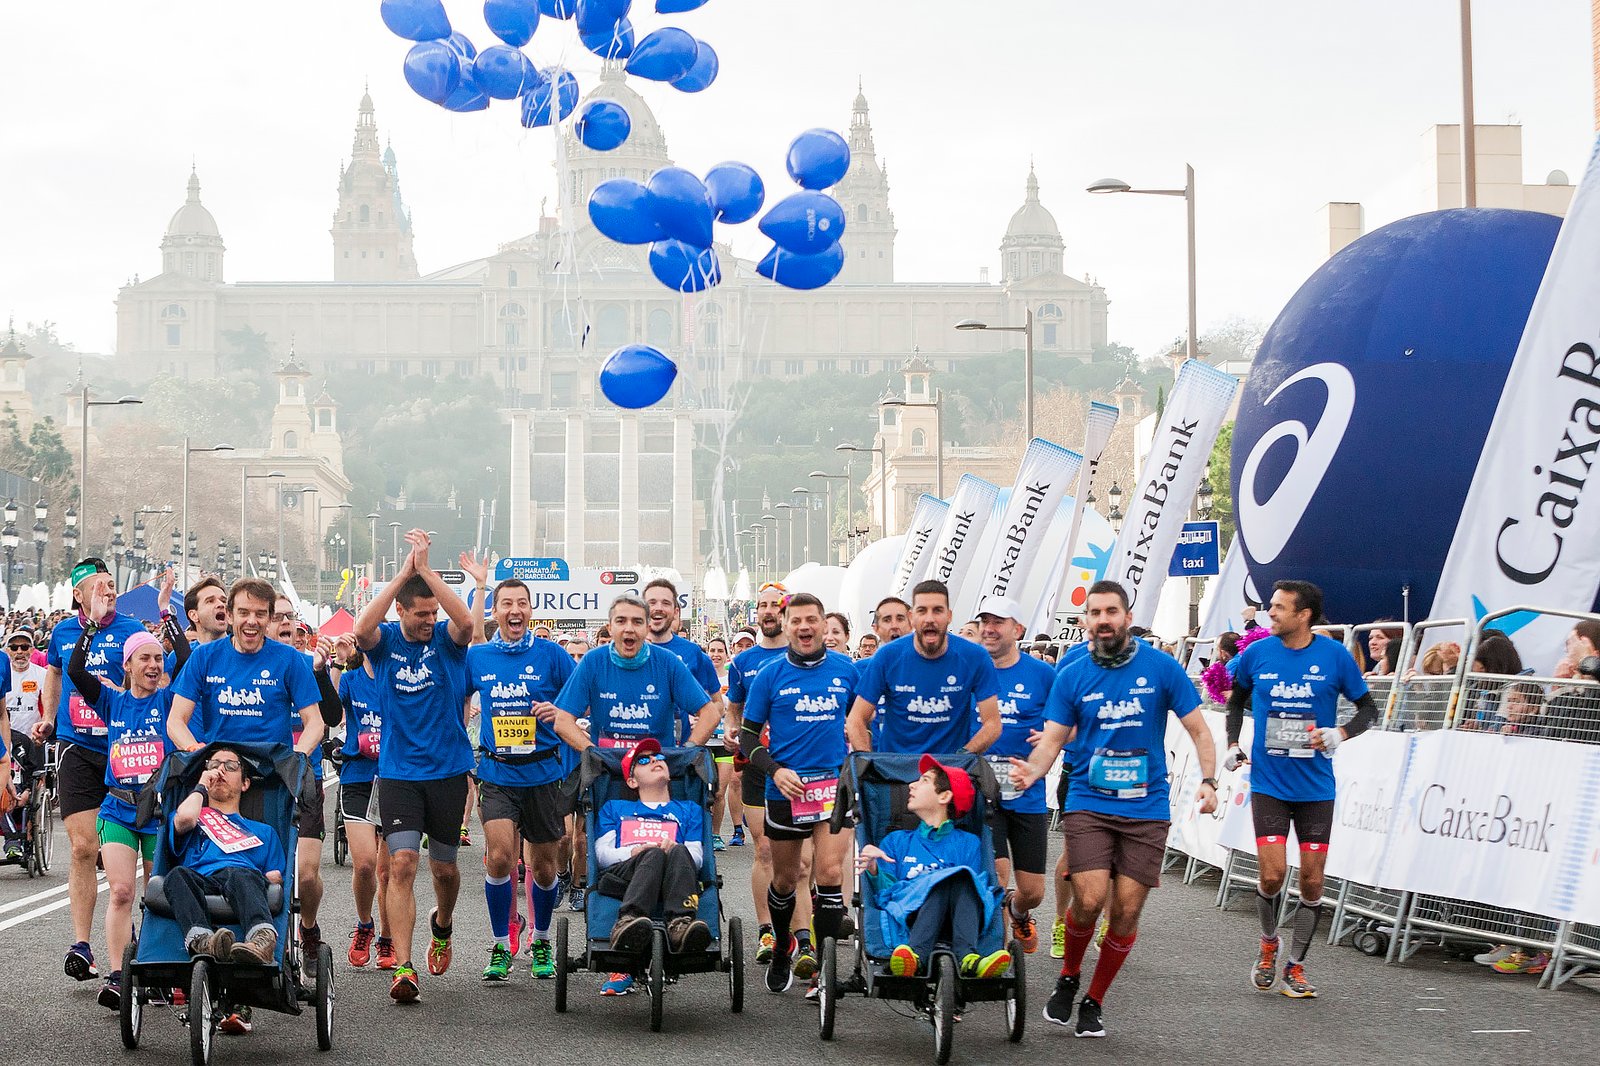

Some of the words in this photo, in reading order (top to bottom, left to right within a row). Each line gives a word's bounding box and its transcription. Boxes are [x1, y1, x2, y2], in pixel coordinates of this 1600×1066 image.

[1494, 338, 1600, 586] CaixaB
[896, 527, 934, 598] xaBank
[1182, 556, 1204, 569] taxi
[531, 592, 598, 610] URICH
[252, 678, 277, 686] ZURICH
[518, 673, 541, 681] ZURICH
[395, 681, 435, 693] #imparables
[940, 685, 962, 693] ZURICH
[1129, 686, 1154, 695] ZURICH
[492, 700, 529, 708] #imparables
[219, 708, 263, 717] #imparables
[907, 715, 951, 724] #imparables
[610, 721, 649, 730] #imparables
[1281, 720, 1304, 731] JAVI
[497, 728, 530, 738] 13399
[1275, 732, 1309, 742] 15723
[120, 743, 158, 756] MARÍA
[121, 755, 158, 768] 18168
[1104, 769, 1138, 782] 3224
[799, 785, 838, 803] 16845
[1418, 783, 1555, 853] CaixaBank
[203, 813, 233, 841] 18174
[632, 829, 669, 839] 18176
